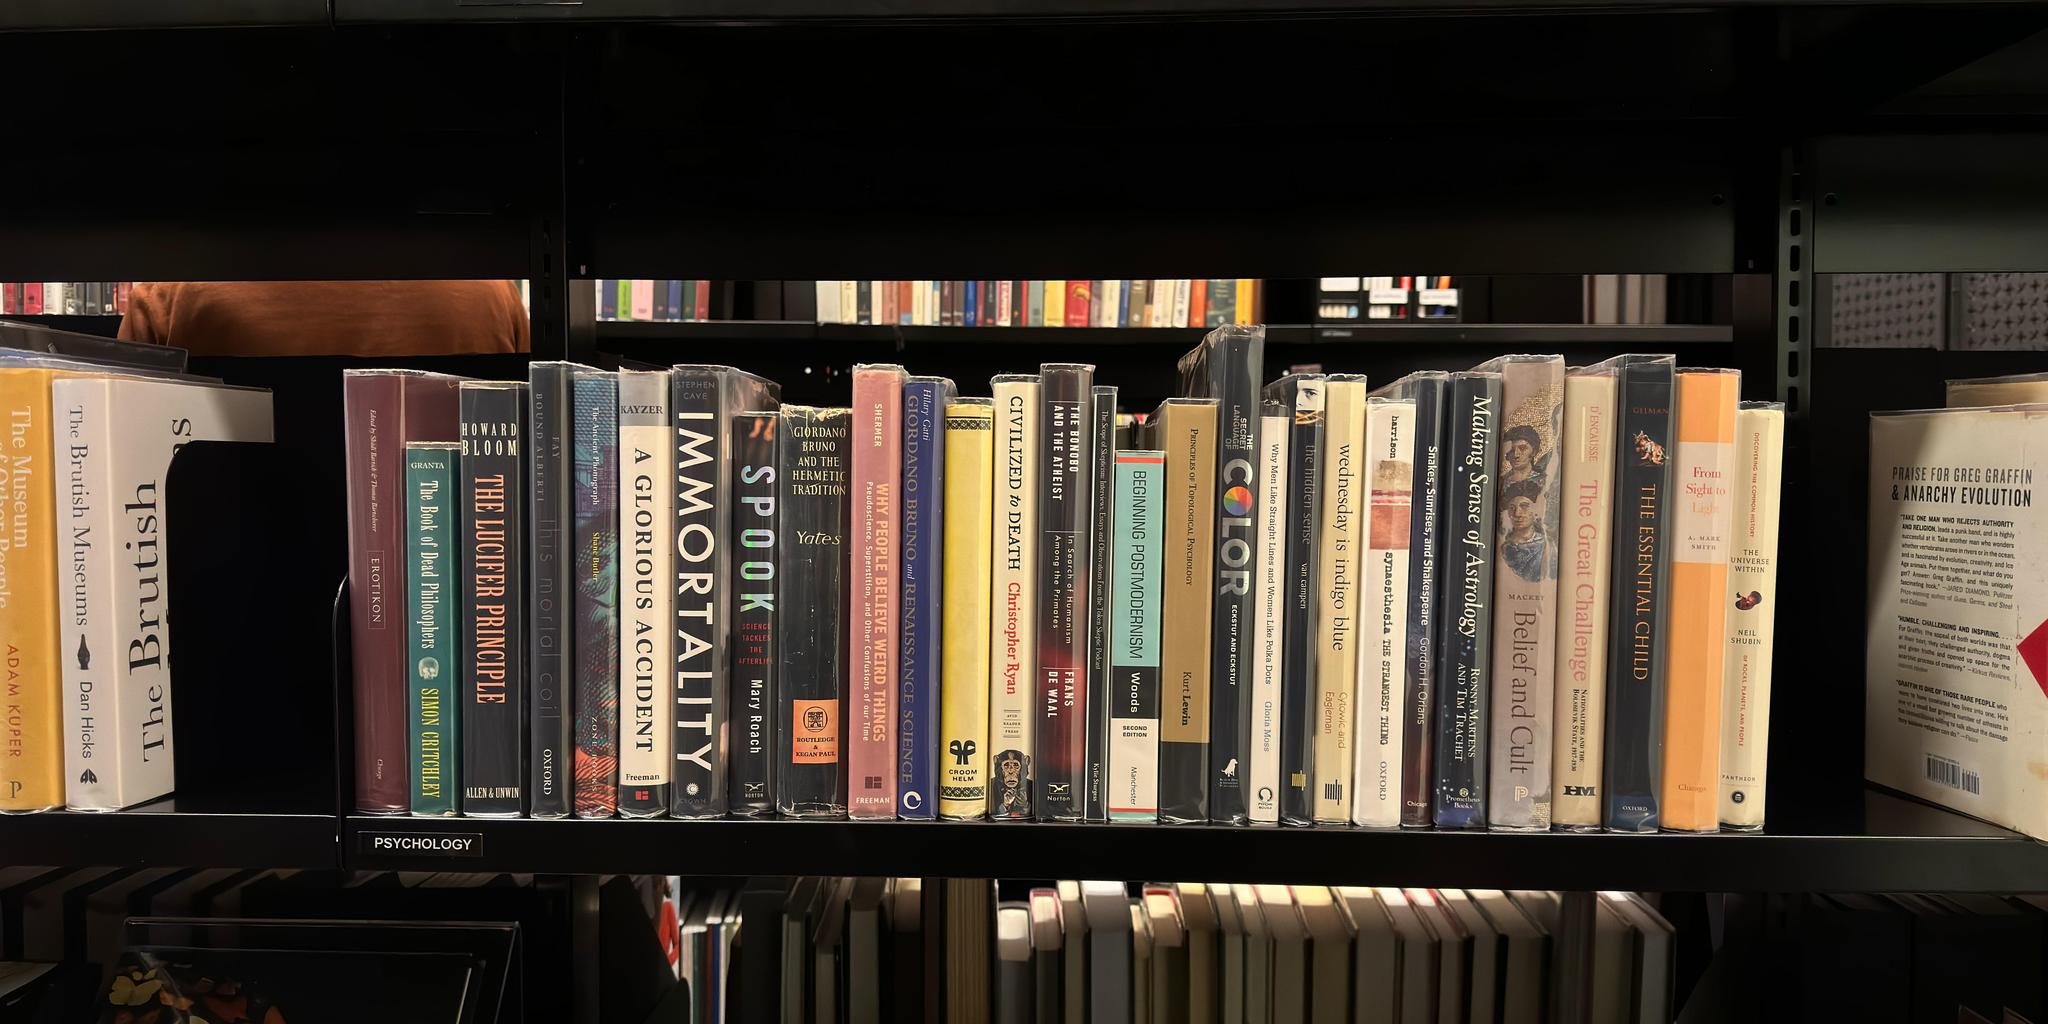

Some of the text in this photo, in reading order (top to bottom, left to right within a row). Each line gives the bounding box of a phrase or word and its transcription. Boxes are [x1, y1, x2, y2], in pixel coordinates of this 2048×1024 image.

[620, 406, 663, 414] KAYZER
[676, 380, 715, 389] STEPHEN
[462, 423, 517, 436] HOWARD
[462, 440, 517, 456] BLOOM
[794, 426, 846, 438] GIORDANO
[802, 441, 836, 452] BRUNO
[874, 404, 882, 447] SHERMER
[1052, 405, 1063, 500] AND THE ATHEIST
[1069, 406, 1080, 472] THE BONOBO
[1232, 405, 1240, 450] LANGUAGE
[1390, 415, 1399, 459] harrison
[1589, 406, 1598, 462] D'ENCAUSSE
[12, 406, 32, 548] The Museum
[792, 470, 847, 482] HERMETIC
[792, 484, 847, 496] TRADITION
[798, 456, 840, 467] AND THE
[1008, 396, 1023, 570] CIVILIZED to DEATH
[1692, 466, 1721, 478] From
[1892, 466, 2032, 485] PRAISE FOR GREG GRAFFIN
[70, 404, 91, 626] The Brutish Museums
[865, 481, 873, 543] Pseudoscience,
[1458, 395, 1492, 638] Making Sense of Astrology
[1892, 484, 2032, 507] & ANARCHY EVOLUTION
[740, 464, 776, 612] SPOOK
[796, 530, 842, 546] Yates
[1220, 458, 1253, 596] COLOR
[1332, 444, 1354, 651] wednesday is indigo blue
[1421, 446, 1438, 626] Snakes, Sunrises, and Shakespeare
[371, 558, 380, 623] EROTIKON
[416, 480, 439, 649] The Book of Dead Philosophers
[474, 474, 506, 704] THE LUCIFER PRINCIPLE
[676, 412, 714, 771] IMMORTALITY
[864, 546, 872, 599] Superstition,
[902, 395, 918, 783] GIORDANO BRUNO and RENAISSANCE SCIENCE
[1130, 471, 1146, 658] BEGINNING POSTMODERNISM
[1568, 480, 1598, 681] The Great Challenge
[1633, 484, 1656, 680] THE ESSENTIAL CHILD
[1730, 557, 1770, 565] UNIVERSE
[124, 480, 164, 762] The Brutish
[539, 518, 561, 718] This mortal coil
[635, 448, 653, 752] A GLORIOUS ACCIDENT
[873, 483, 888, 742] WHY PEOPLE BELIEVE WEIRD THINGS
[863, 646, 871, 690] Confusions
[1004, 582, 1020, 695] Christopher Ryan
[8, 644, 22, 758] ADAM KUPER
[80, 682, 94, 758] Dan Hicks
[748, 679, 763, 754] Mary Roach
[863, 694, 872, 702] of
[1047, 671, 1058, 718] DE WAAL
[1064, 671, 1074, 707] FRANS
[1130, 672, 1140, 713] Woods
[1181, 672, 1191, 726] Kurt Lewin
[1468, 668, 1481, 758] RONNY MARTENS
[1510, 611, 1538, 774] Belief and Cult
[421, 688, 440, 798] SIMON CRITCHLEY
[543, 749, 552, 795] OXFORD
[465, 787, 519, 798] ALLEN & UNWIN
[1379, 761, 1388, 800] OXFORD
[374, 837, 472, 850] PSYCHOLOGY
